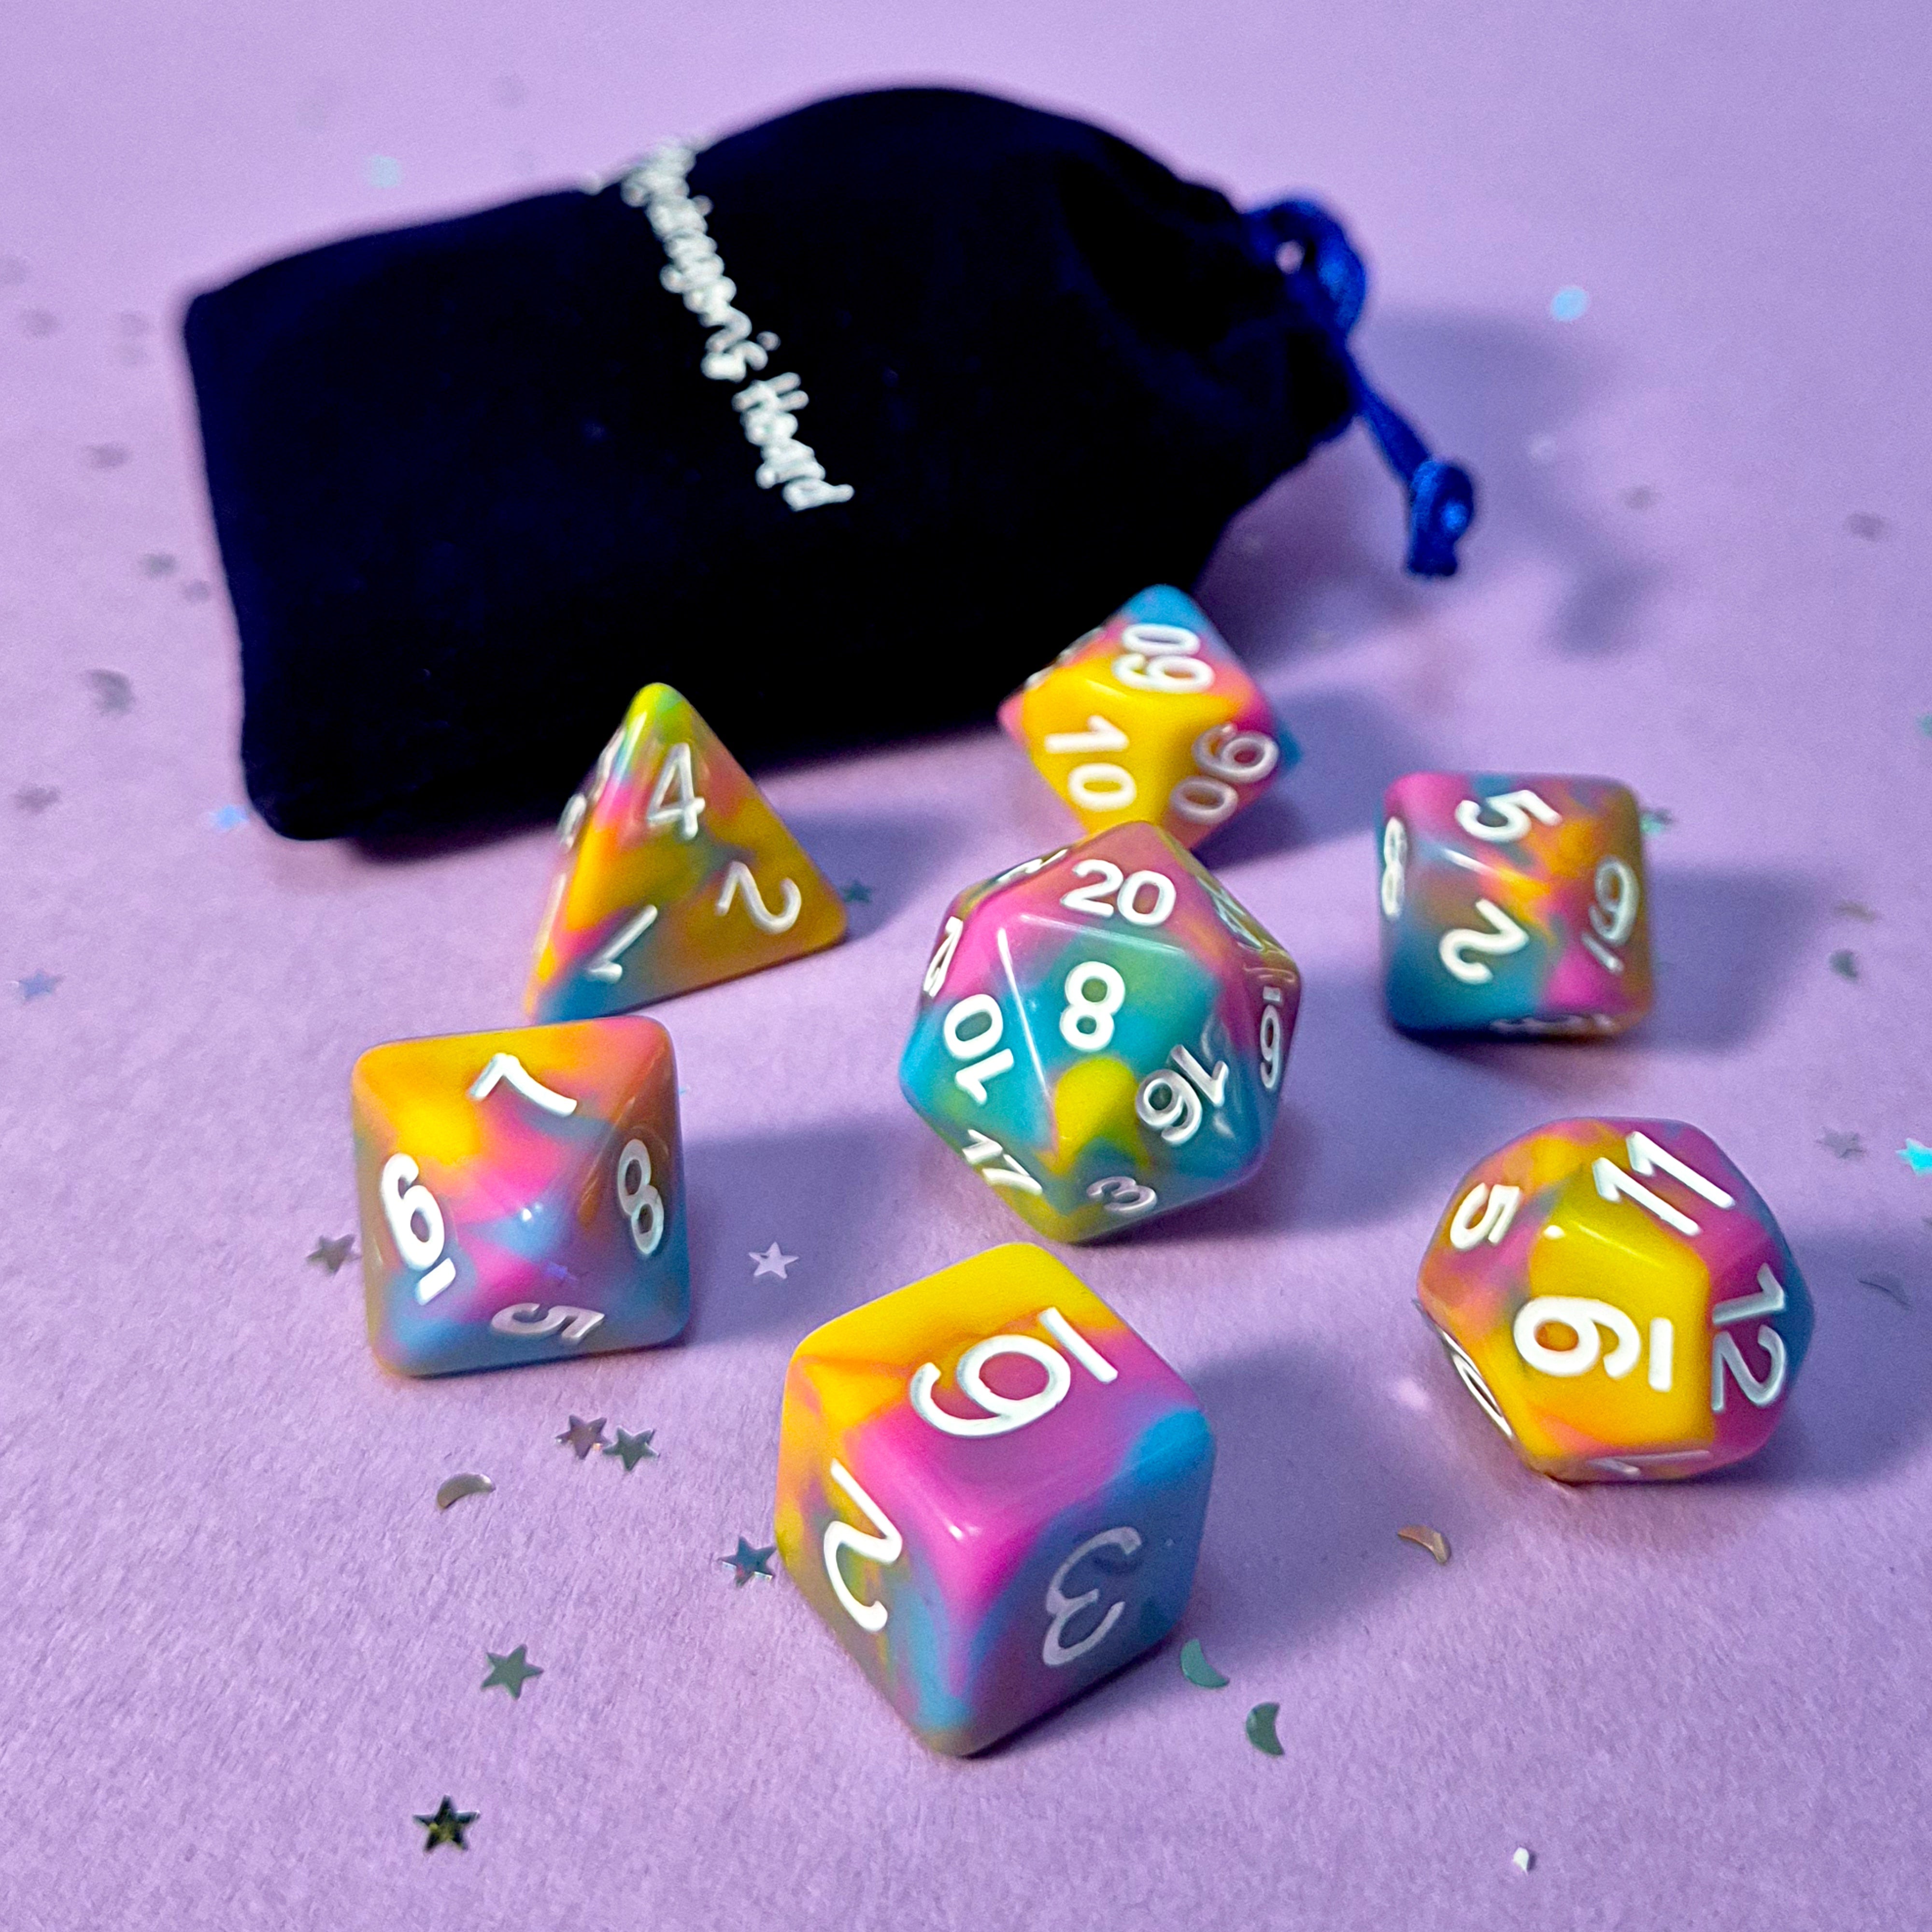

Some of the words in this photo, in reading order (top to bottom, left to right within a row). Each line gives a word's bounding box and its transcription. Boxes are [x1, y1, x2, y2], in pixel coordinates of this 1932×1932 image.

[646, 742, 705, 839] 4
[1044, 715, 1137, 812] 10
[1455, 790, 1563, 841] 5
[715, 861, 801, 934] 2
[1060, 859, 1177, 926] 20
[1381, 816, 1407, 918] 8
[585, 905, 657, 983] 1
[1439, 898, 1529, 984] 2
[944, 994, 1014, 1105] 10
[1060, 961, 1125, 1051] 8
[469, 1052, 578, 1117] 7
[1135, 1045, 1229, 1146] 16
[617, 1138, 664, 1256] 8
[962, 1129, 1042, 1196] 17
[1087, 1176, 1158, 1214] 3
[1592, 1131, 1735, 1236] 11
[380, 1152, 456, 1305] 6
[1450, 1183, 1520, 1250] 5
[491, 1303, 605, 1340] 5
[1712, 1263, 1786, 1413] 12
[824, 1458, 903, 1632] 2
[1043, 1526, 1142, 1667] 3
